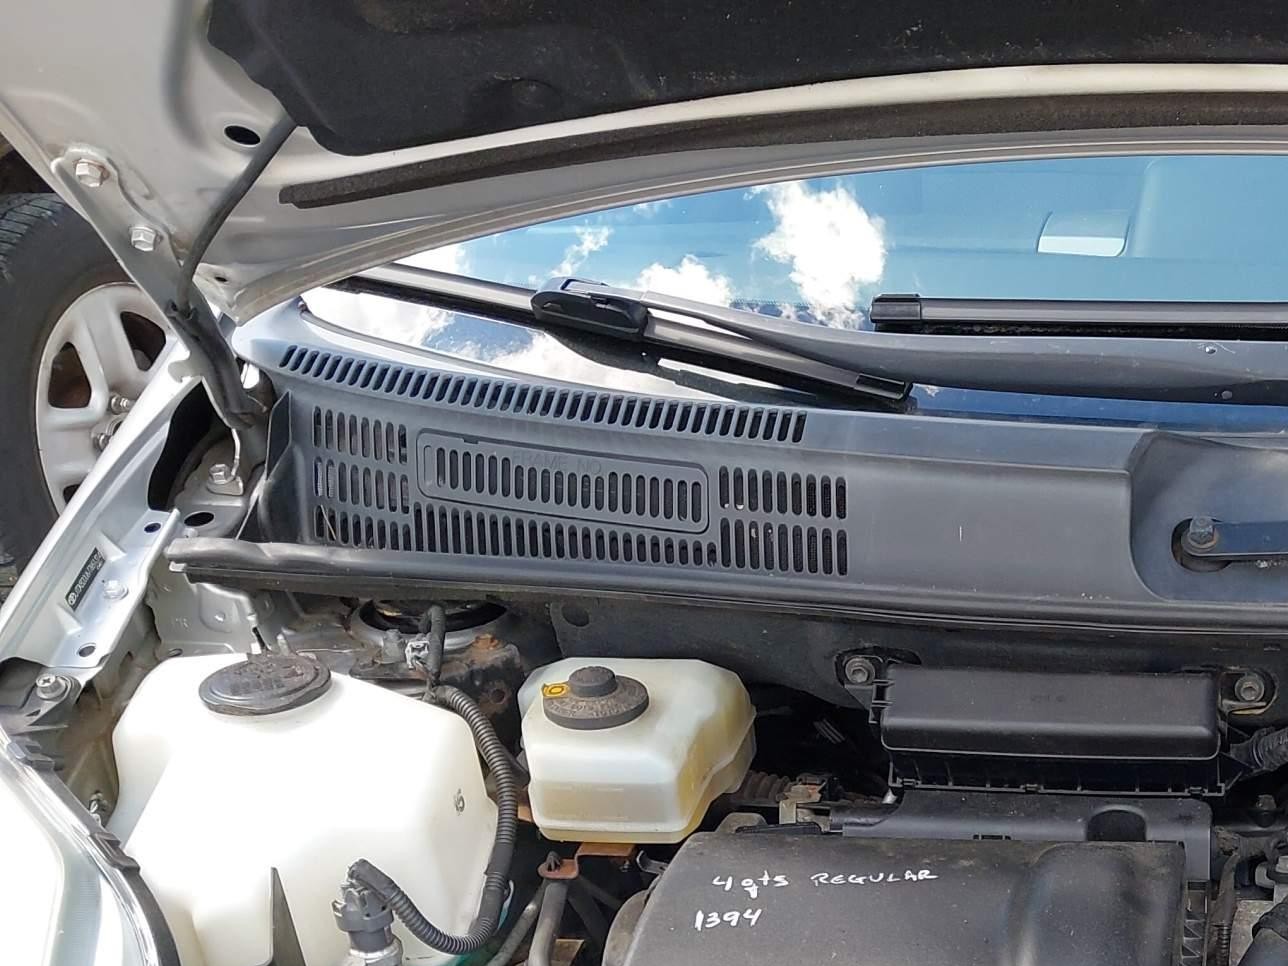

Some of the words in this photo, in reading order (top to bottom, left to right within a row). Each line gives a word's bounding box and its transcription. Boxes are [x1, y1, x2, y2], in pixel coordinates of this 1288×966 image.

[712, 875, 733, 891] 4
[810, 869, 938, 887] REGULAR
[694, 909, 763, 931] 1394
